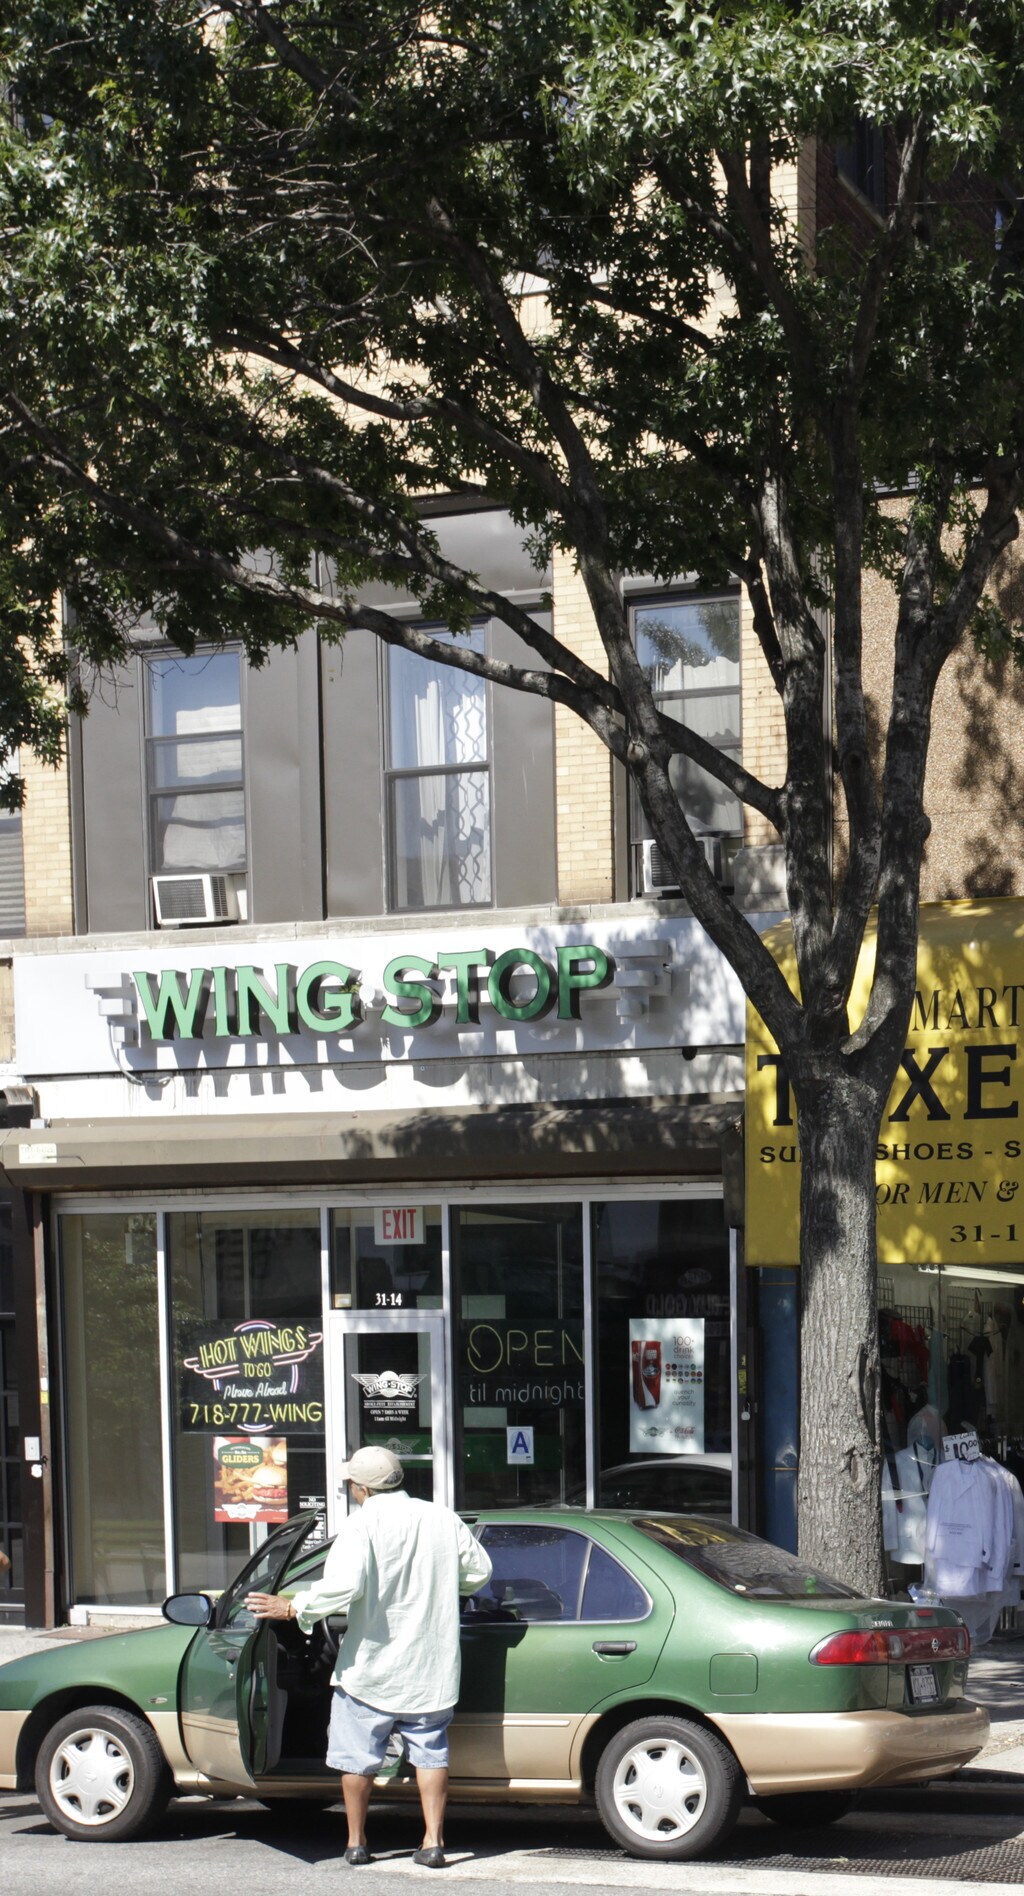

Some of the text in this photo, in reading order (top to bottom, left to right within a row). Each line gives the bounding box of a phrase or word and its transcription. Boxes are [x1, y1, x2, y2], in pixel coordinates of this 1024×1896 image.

[132, 944, 613, 1041] WING STOP
[876, 1142, 974, 1160] SHOES
[875, 1182, 910, 1206] OR
[917, 1180, 989, 1204] MEN
[996, 1180, 1020, 1202] &
[382, 1208, 417, 1239] EXIT
[375, 1292, 403, 1306] 31-14
[199, 1325, 308, 1368] HOT WINGS
[466, 1324, 585, 1373] OPEN
[469, 1380, 584, 1406] til midnight
[189, 1401, 323, 1426] 718-777-WING
[511, 1431, 530, 1454] A
[222, 1454, 260, 1464] GLIDERS
